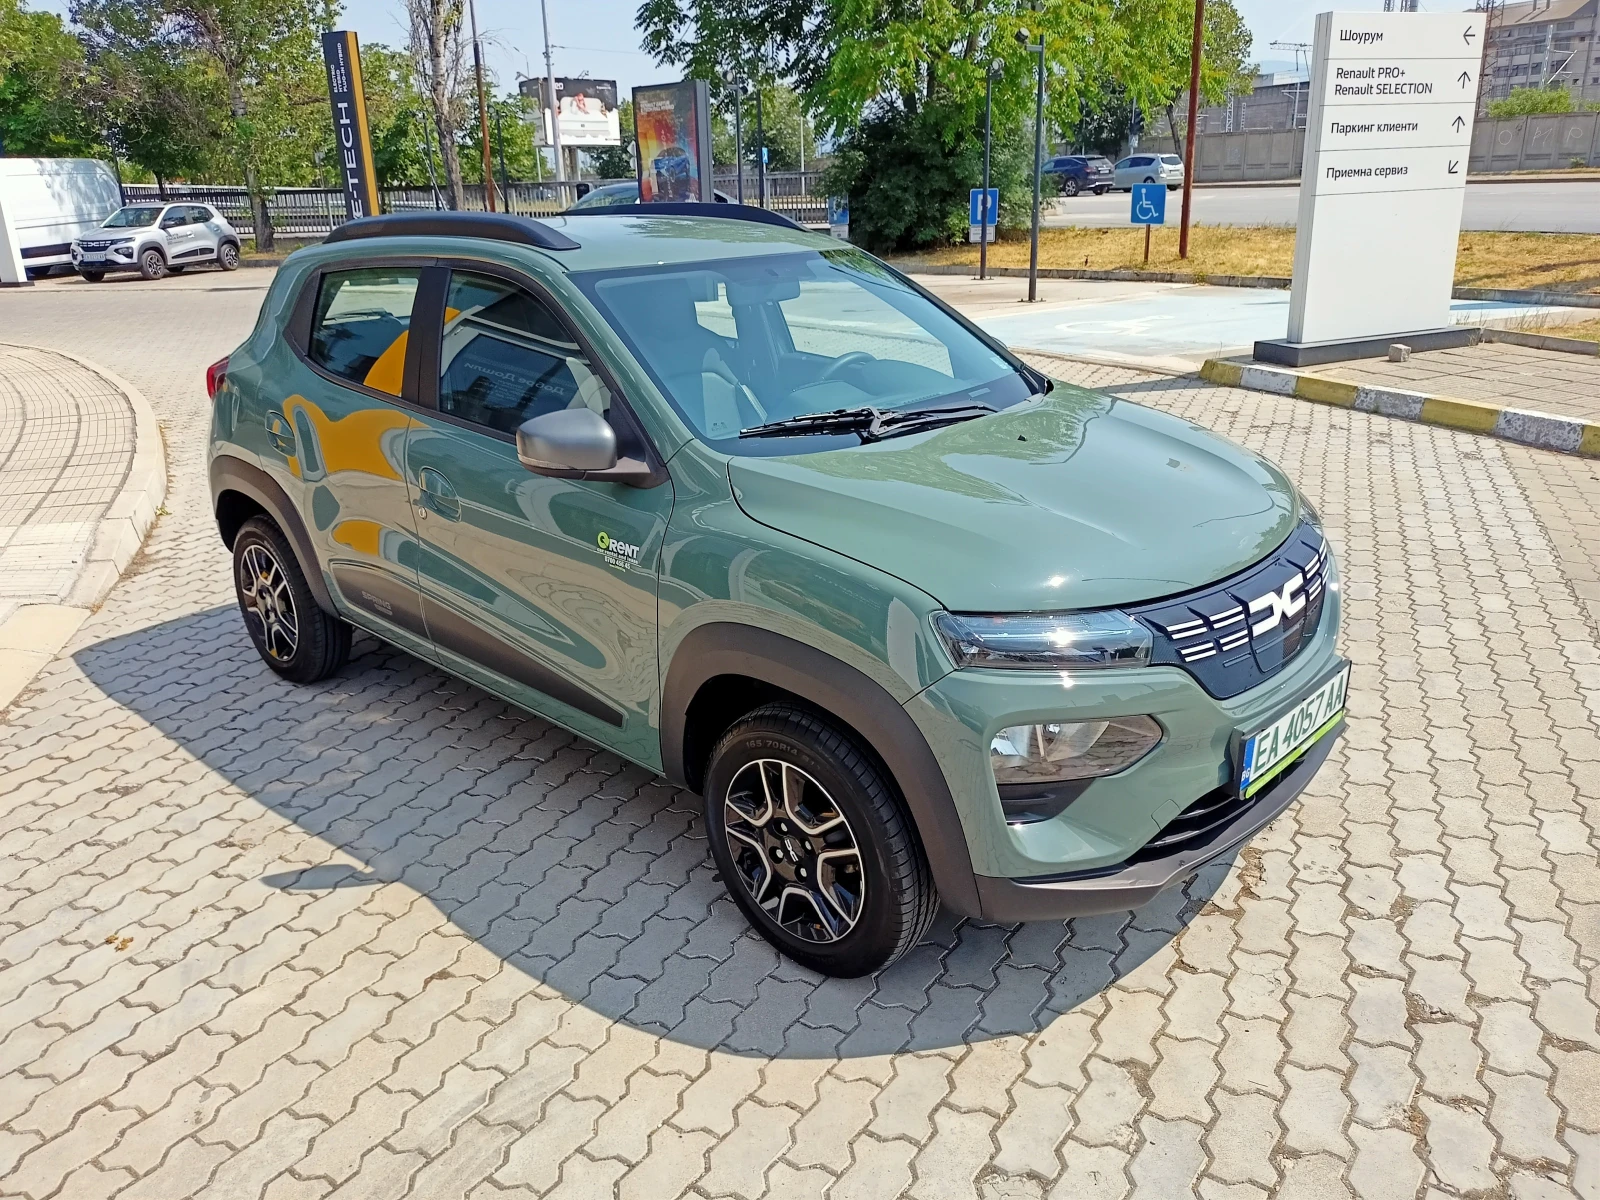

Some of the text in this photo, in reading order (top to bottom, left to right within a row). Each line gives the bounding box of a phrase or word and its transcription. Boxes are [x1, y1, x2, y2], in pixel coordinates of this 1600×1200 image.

[1339, 29, 1384, 45] Шоурум
[1336, 66, 1406, 79] Renault PRO+
[1334, 82, 1433, 96] Renault SELECTION
[1330, 122, 1419, 136] Паркинг клиенти
[337, 102, 364, 219] E-TECH
[1326, 166, 1409, 181] Приемна сервиз
[976, 194, 992, 221] P
[1253, 726, 1280, 775] EA
[1281, 689, 1326, 750] 4057
[1323, 674, 1344, 719] AA
[1241, 767, 1251, 781] BG
